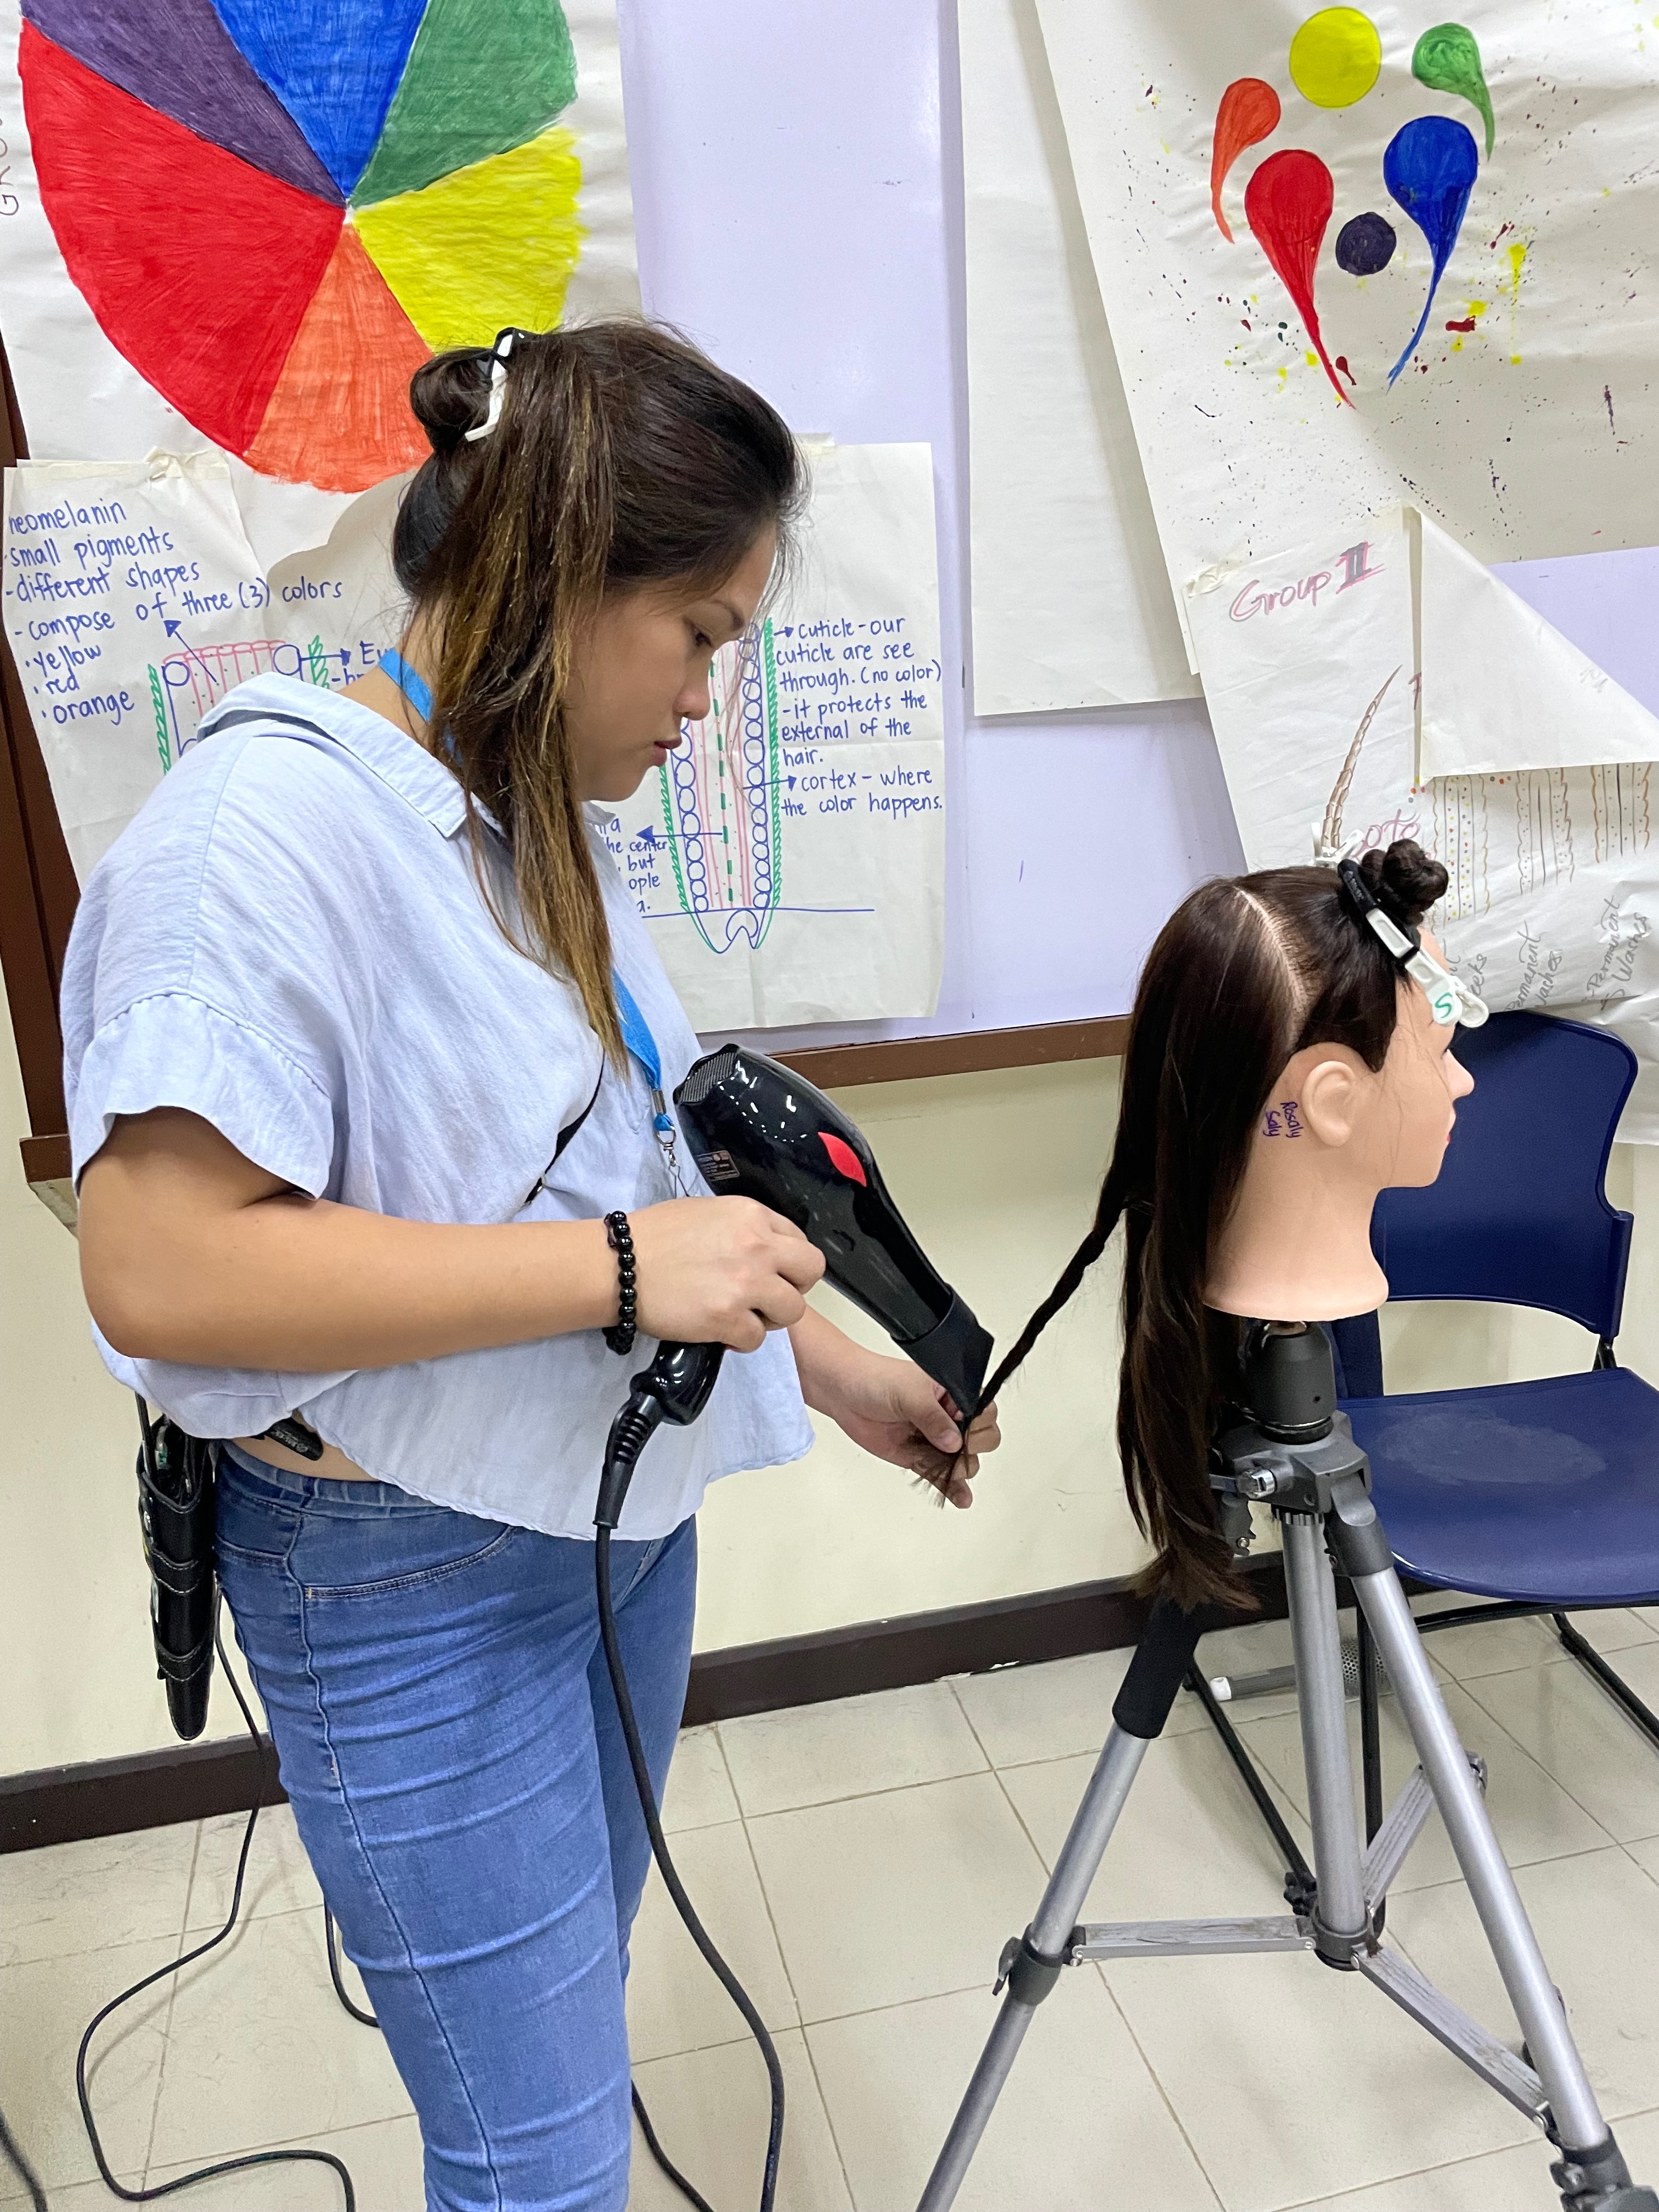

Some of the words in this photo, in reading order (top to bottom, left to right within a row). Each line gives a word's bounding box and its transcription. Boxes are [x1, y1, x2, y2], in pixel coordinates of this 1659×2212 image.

[10, 538, 61, 567] small
[74, 526, 175, 569] pigments
[126, 561, 199, 592] shapes
[136, 595, 168, 622] of
[182, 590, 232, 616] three
[239, 577, 270, 608] (3)
[282, 576, 342, 602] colors
[1229, 571, 1331, 622] Group
[33, 645, 101, 684] yellow
[776, 642, 834, 666] cuticle
[843, 645, 873, 661] are
[883, 642, 913, 659] see
[779, 668, 855, 695] through.
[860, 667, 888, 684] (no
[895, 659, 941, 682] color)
[51, 687, 134, 726] orange
[817, 693, 892, 725] protects
[900, 690, 927, 709] the
[781, 718, 849, 742] external
[860, 717, 878, 736] of
[885, 718, 911, 737] the
[782, 748, 823, 767] hair.
[802, 769, 856, 792] cortex
[880, 766, 932, 786] where
[781, 798, 807, 817] the
[819, 795, 856, 813] color
[869, 792, 942, 819] happens.
[606, 836, 623, 854] he
[628, 872, 660, 895] ople
[1467, 953, 1487, 996] eeks
